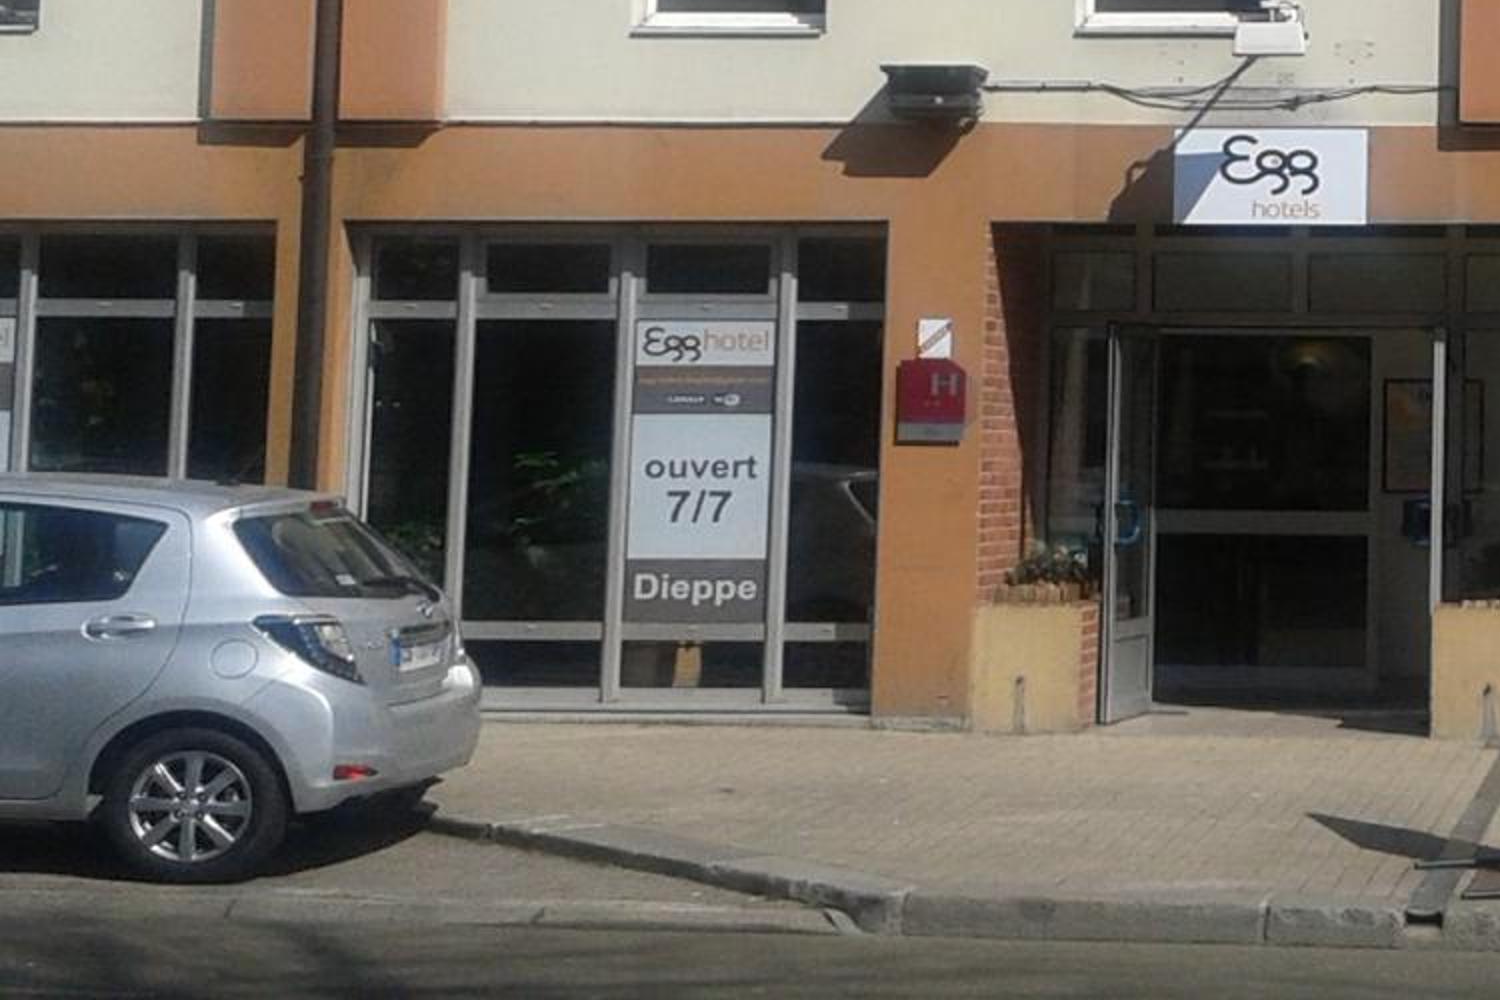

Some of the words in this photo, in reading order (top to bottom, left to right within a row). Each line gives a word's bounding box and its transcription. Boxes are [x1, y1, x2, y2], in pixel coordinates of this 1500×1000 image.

[1220, 135, 1319, 195] Egg
[1251, 200, 1321, 219] hotels
[645, 456, 757, 479] ouvert
[666, 489, 733, 523] 7/7
[634, 574, 757, 606] Dieppe
